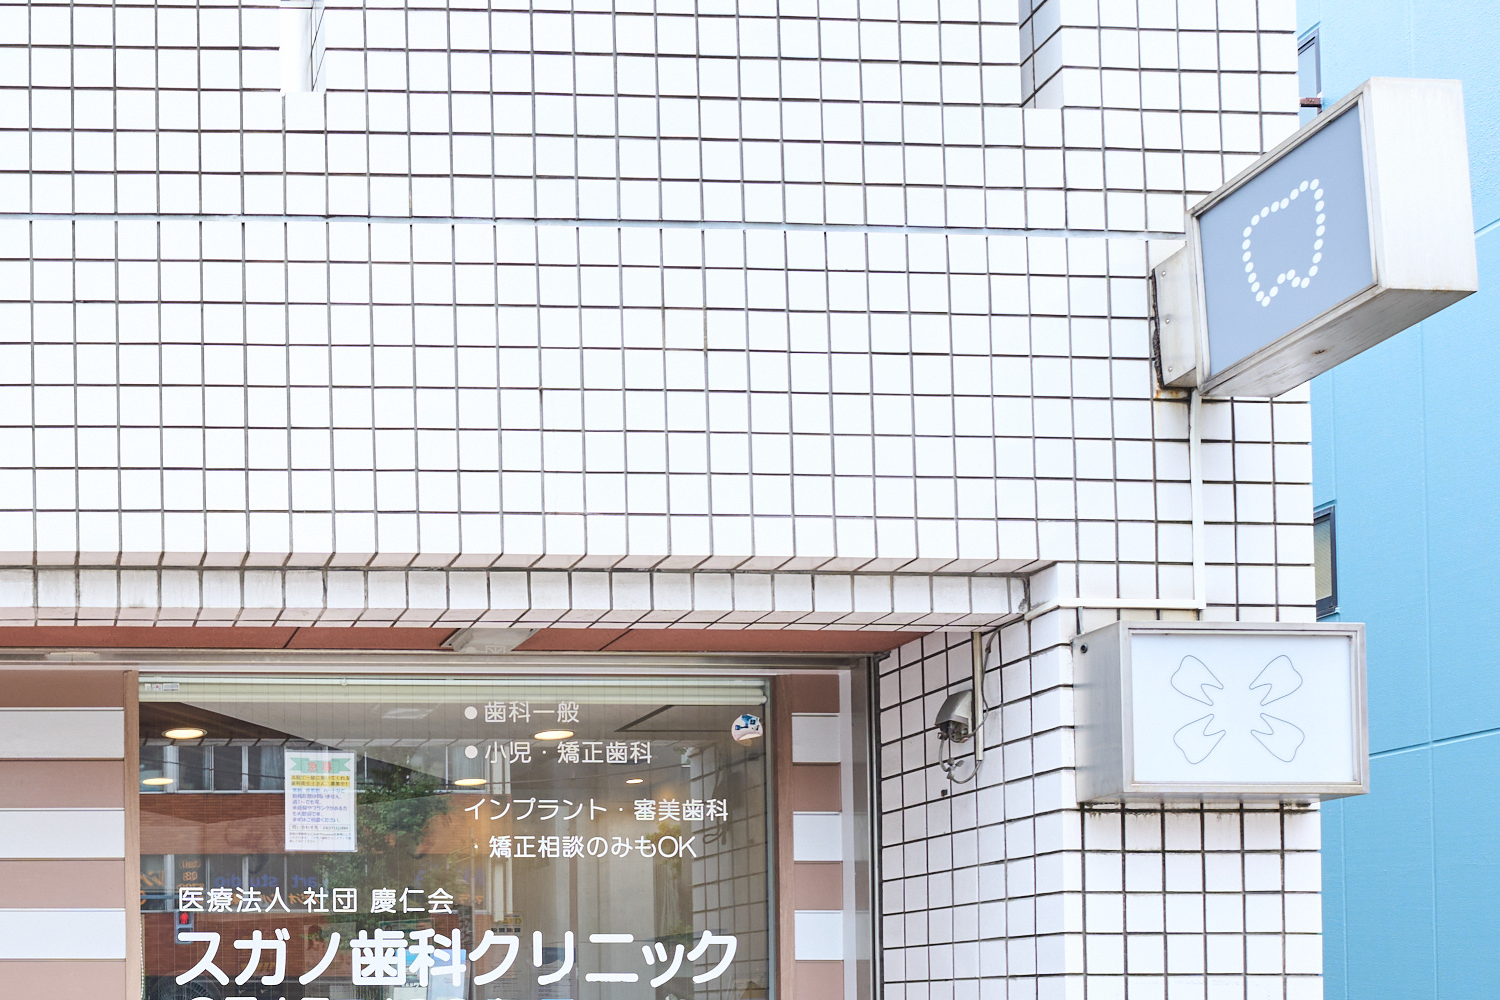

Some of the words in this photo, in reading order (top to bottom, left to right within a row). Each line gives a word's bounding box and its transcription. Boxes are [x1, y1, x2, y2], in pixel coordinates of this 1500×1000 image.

[483, 701, 580, 723] 歯科一般
[484, 741, 652, 764] 小児・矯正歯科
[464, 797, 729, 822] インプラント・審美歯科
[178, 886, 291, 914] 医療法人
[303, 886, 358, 914] 社団
[370, 886, 455, 914] 慶仁会
[175, 928, 738, 988] スガノ歯科クリニック
